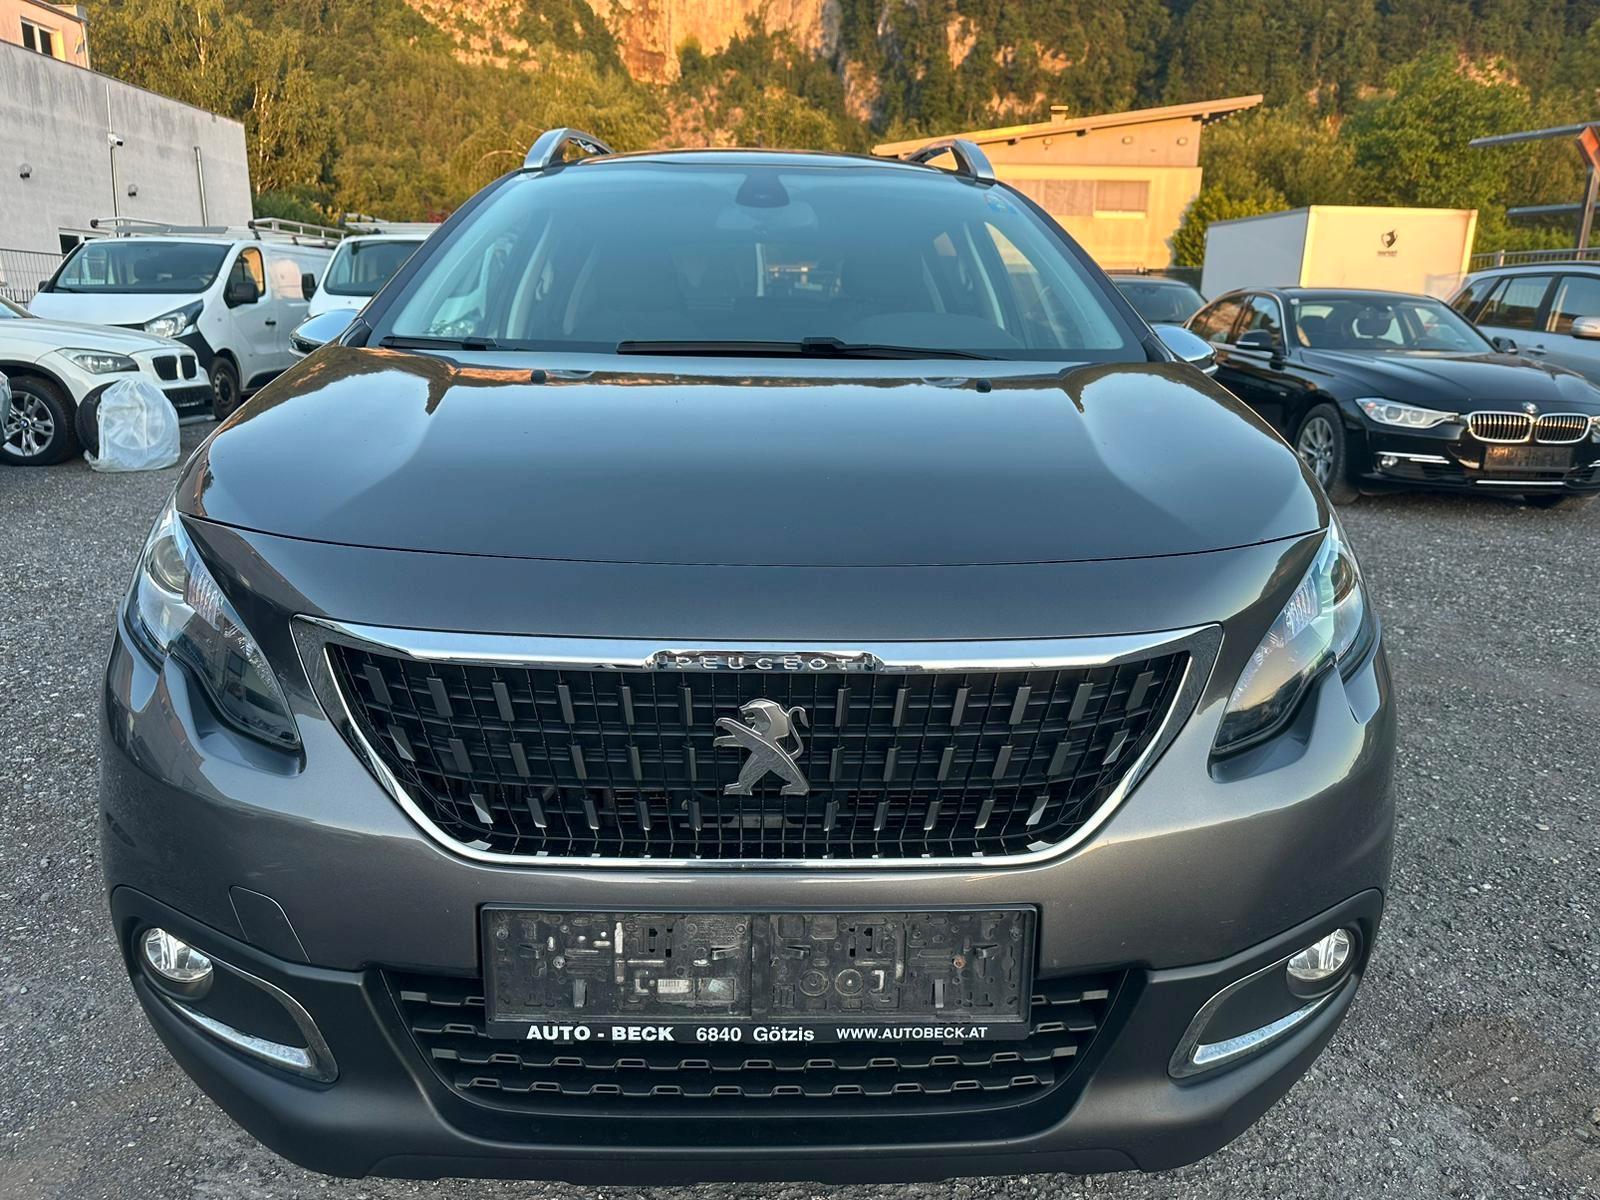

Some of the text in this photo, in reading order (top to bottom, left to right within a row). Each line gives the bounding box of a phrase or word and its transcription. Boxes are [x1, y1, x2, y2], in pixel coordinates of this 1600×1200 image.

[675, 655, 854, 671] PEUGEOT
[526, 1025, 591, 1041] AUTO
[611, 1026, 675, 1041] BECK
[695, 1027, 742, 1042] 6840
[752, 1026, 815, 1042] Götzis
[836, 1026, 988, 1040] WWW.AUTOBECK.AT
